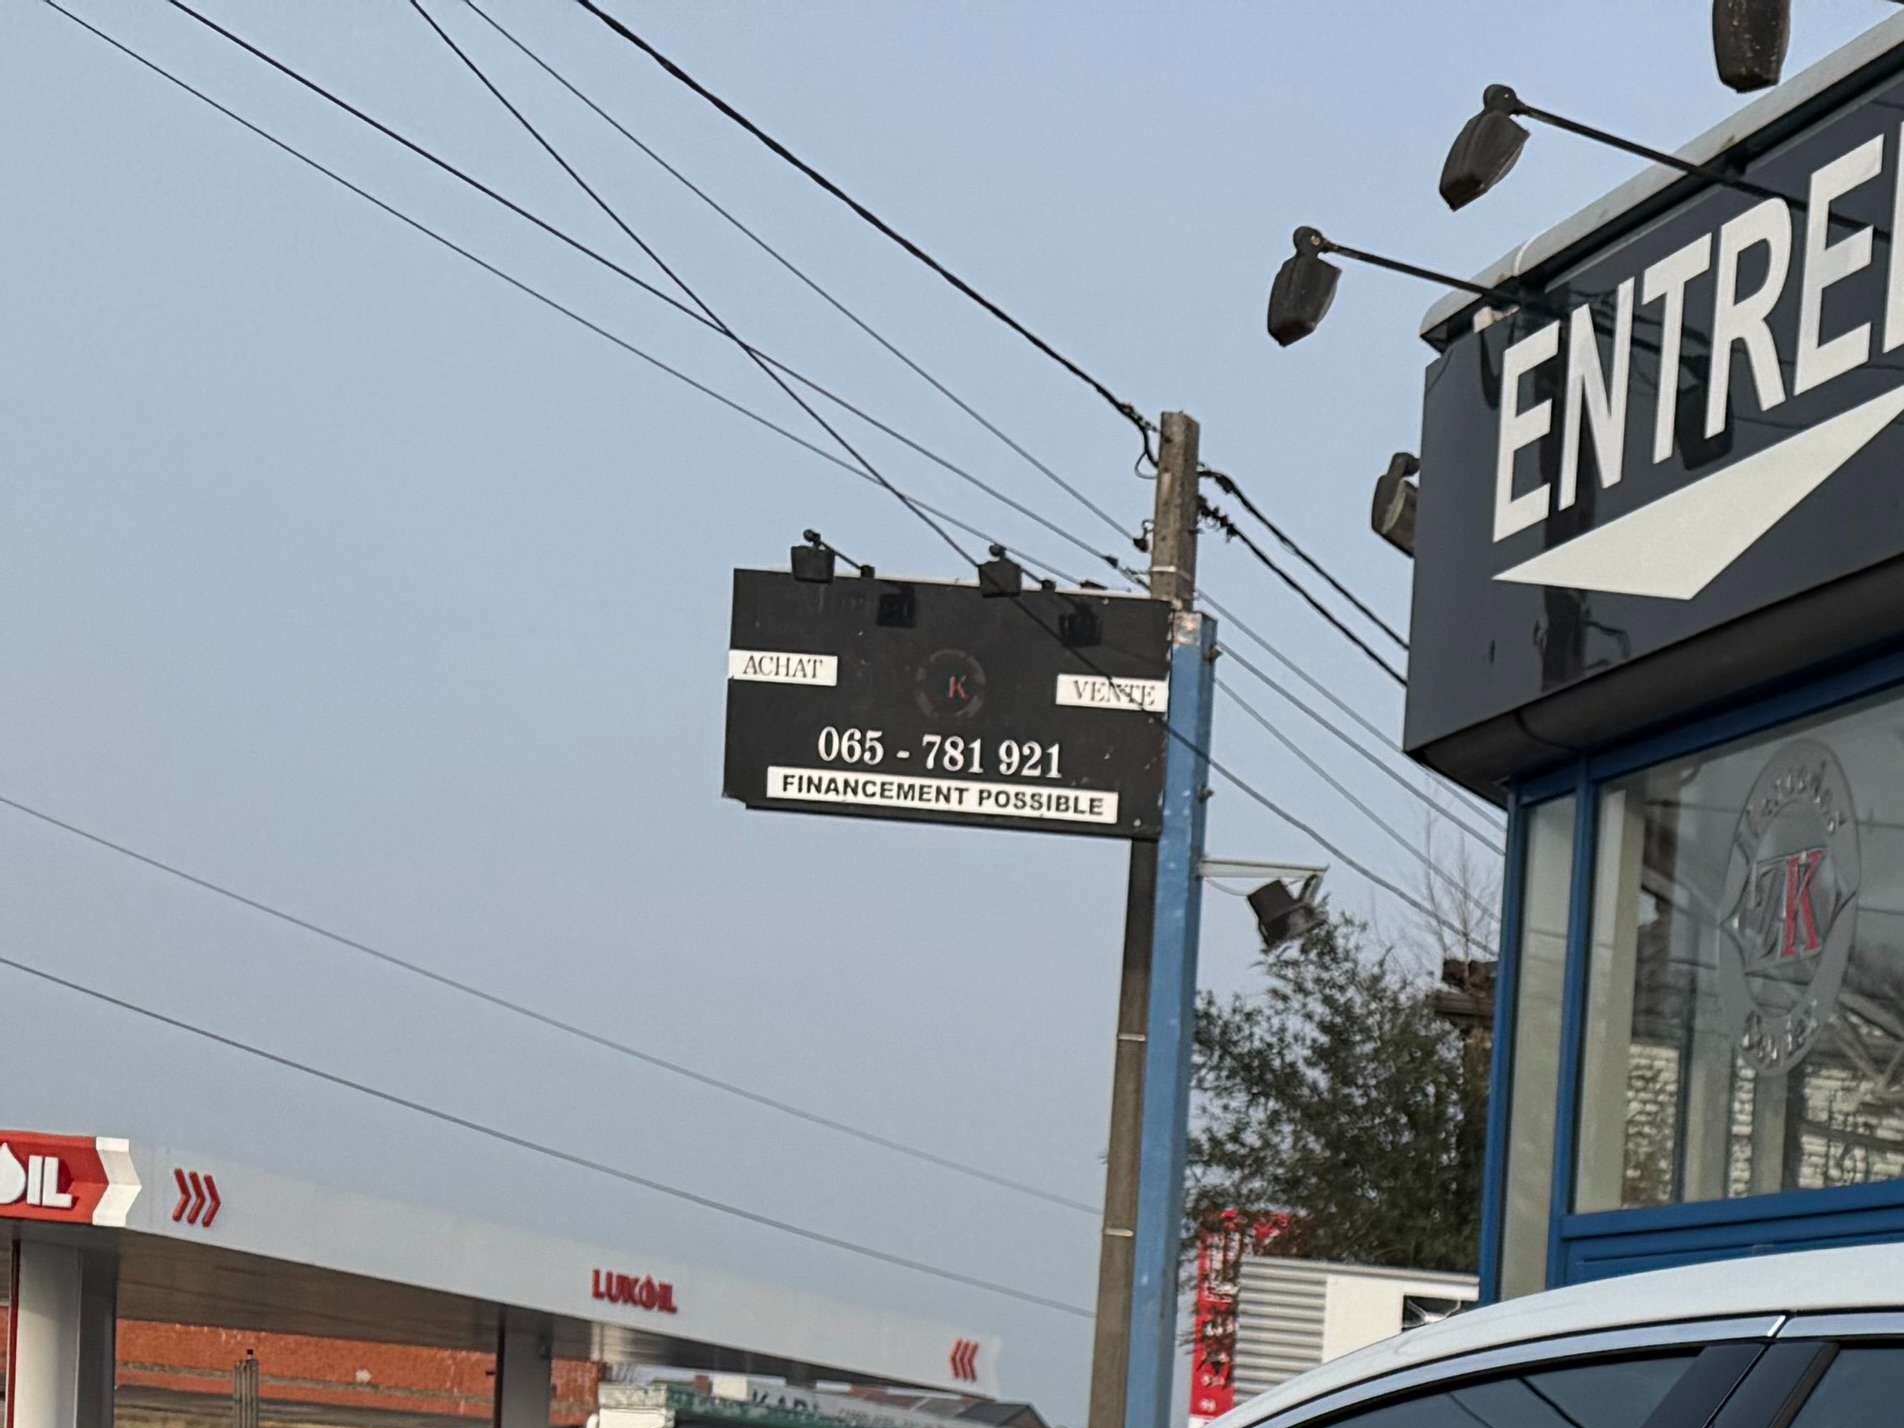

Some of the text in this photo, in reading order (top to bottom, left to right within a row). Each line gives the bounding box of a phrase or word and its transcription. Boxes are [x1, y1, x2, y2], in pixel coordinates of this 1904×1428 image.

[743, 655, 823, 679] ACHAT
[1073, 680, 1157, 706] VENTE
[817, 726, 885, 766] 065
[921, 734, 985, 774] 781
[998, 739, 1063, 779] 921
[782, 774, 1104, 817] FINANCEMENT POSSIBLE
[592, 1269, 678, 1315] LUKOIL
